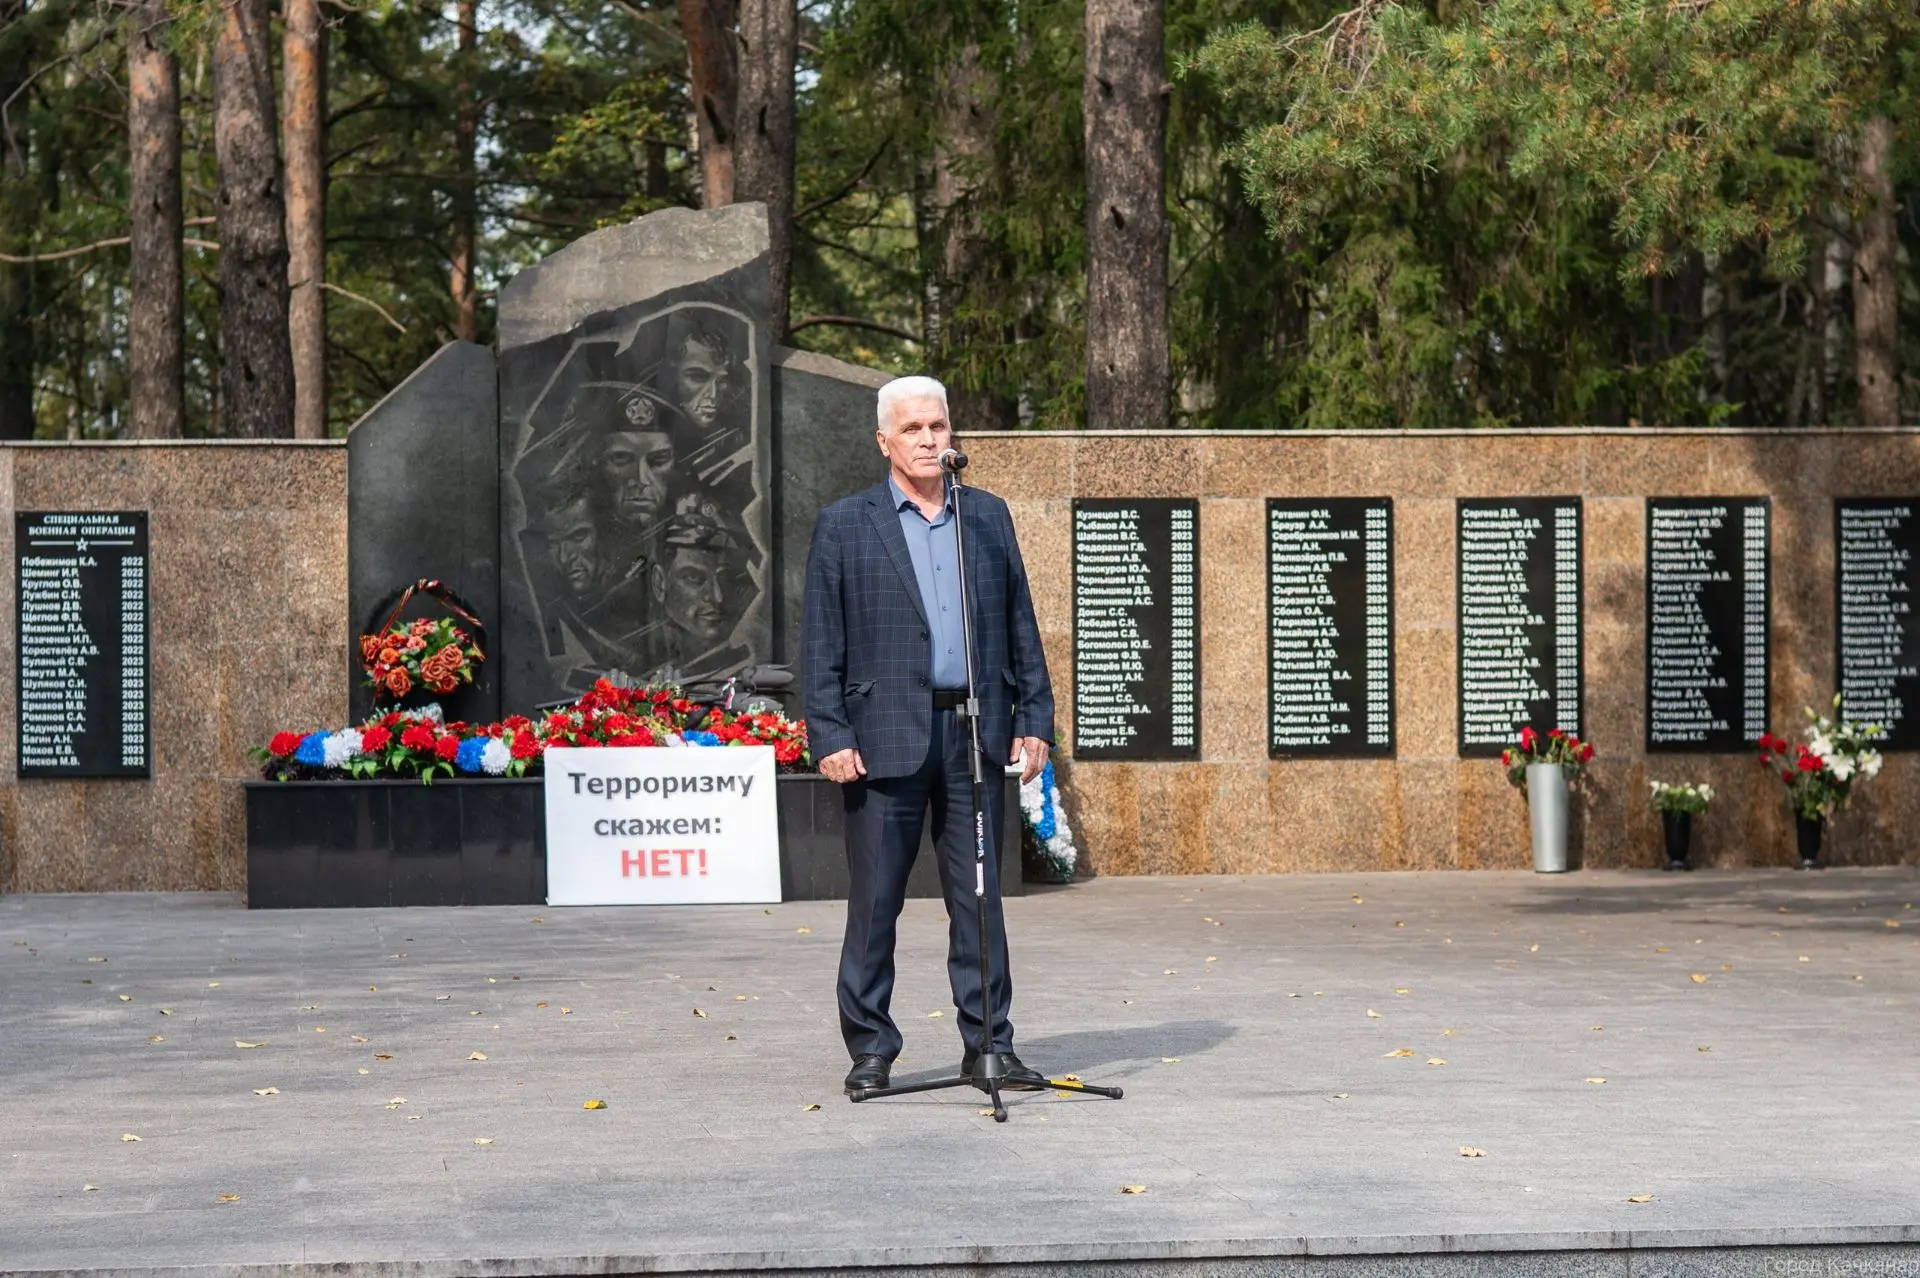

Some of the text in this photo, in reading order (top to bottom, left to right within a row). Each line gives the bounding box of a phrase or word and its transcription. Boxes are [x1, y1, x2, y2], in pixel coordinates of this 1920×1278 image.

[1171, 510, 1192, 519] 2023
[44, 515, 119, 525] СПЕЦИАЛЬНАЯ
[1171, 521, 1192, 530] 2023
[28, 526, 136, 536] ВОЕННАЯ ОПЕРАЦИЯ
[1171, 532, 1192, 541] 2023
[1171, 543, 1192, 552] 2023
[122, 557, 143, 566] 2022
[1172, 554, 1193, 563] 2023
[122, 568, 143, 577] 2022
[1172, 564, 1193, 573] 2023
[122, 579, 143, 588] 2022
[1172, 575, 1193, 584] 2023
[122, 590, 143, 599] 2022
[1172, 586, 1193, 595] 2023
[1172, 597, 1193, 606] 2023
[122, 602, 143, 611] 2022
[1172, 608, 1193, 617] 2023
[122, 613, 143, 622] 2022
[1172, 618, 1193, 627] 2023
[122, 624, 143, 633] 2022
[1172, 629, 1193, 638] 2024
[122, 635, 144, 644] 2022
[1172, 640, 1193, 649] 2024
[122, 646, 144, 655] 2022
[1172, 651, 1193, 660] 2024
[122, 657, 144, 666] 2023
[1172, 662, 1193, 671] 2024
[122, 668, 144, 677] 2023
[1172, 673, 1193, 682] 2024
[122, 679, 144, 688] 2023
[1172, 683, 1193, 692] 2024
[122, 690, 144, 699] 2023
[1172, 694, 1193, 703] 2024
[122, 701, 144, 710] 2023
[1172, 705, 1193, 714] 2024
[122, 712, 144, 721] 2023
[1172, 716, 1194, 725] 2024
[122, 723, 144, 732] 2023
[1172, 727, 1194, 736] 2024
[123, 734, 144, 743] 2023
[1172, 737, 1194, 746] 2024
[123, 745, 144, 754] 2023
[123, 757, 144, 766] 2023
[568, 772, 754, 800] Терроризму
[594, 817, 722, 836] скажем:
[621, 849, 708, 878] НЕТ!
